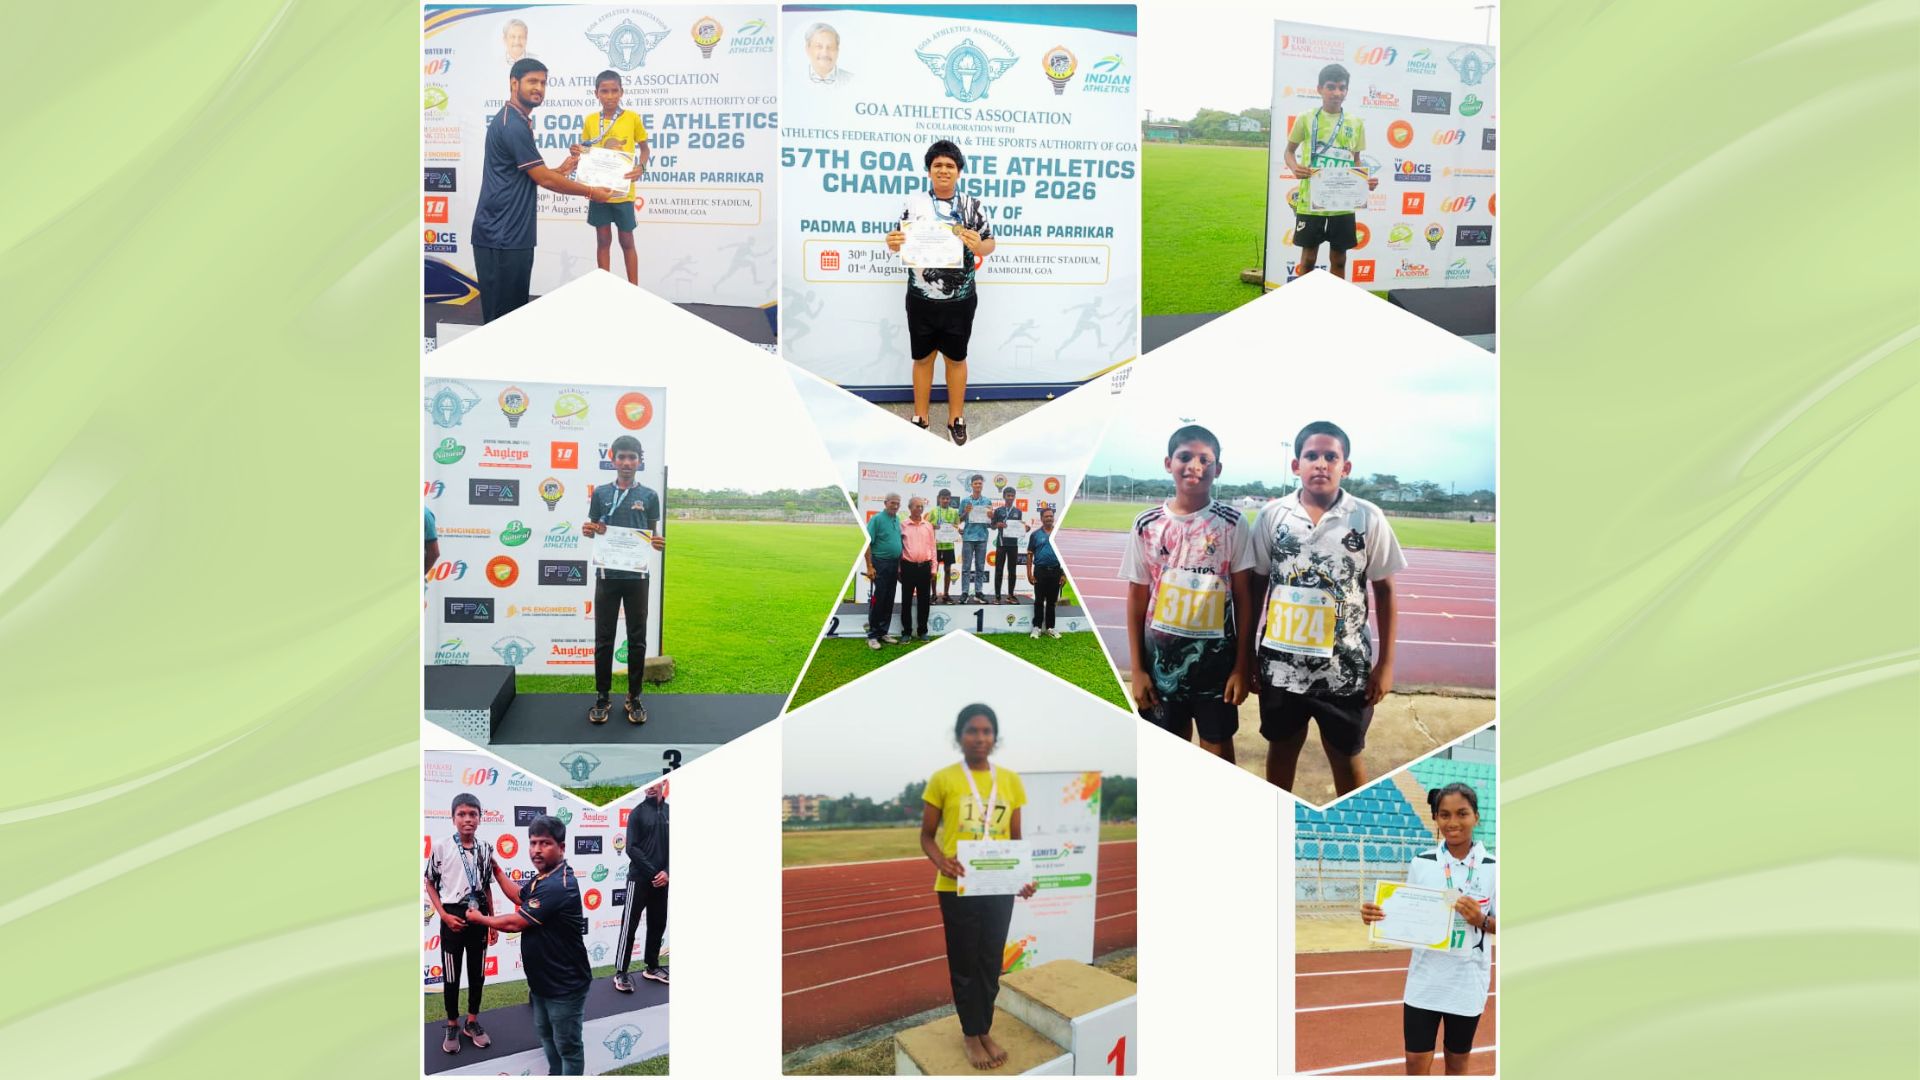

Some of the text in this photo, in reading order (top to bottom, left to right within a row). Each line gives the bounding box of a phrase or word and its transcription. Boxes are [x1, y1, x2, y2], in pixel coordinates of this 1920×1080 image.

[731, 36, 775, 46] INDIAN
[729, 45, 774, 54] ATHLETICS
[1407, 60, 1437, 70] INDIAN
[546, 76, 567, 87] OA
[635, 73, 720, 85] ASSOCIATION
[1085, 73, 1132, 85] INDIAN
[1083, 84, 1130, 94] ATHLETICS
[541, 99, 580, 108] DERATION
[584, 99, 597, 107] OF
[635, 98, 652, 107] THE
[654, 97, 688, 107] SPORTS
[690, 96, 745, 106] AUTHORITY
[747, 96, 759, 105] OF
[855, 102, 1072, 125] GOA ATHLETICS ASSOCIATION
[544, 114, 584, 130] GOA
[662, 112, 778, 130] ATHLETICS
[926, 122, 993, 132] COLLABORATION
[688, 132, 745, 149] 2026
[842, 130, 911, 143] FEDERATION
[914, 134, 928, 144] OF
[965, 136, 973, 145] &
[976, 136, 995, 146] THE
[999, 137, 1037, 148] SPORTS
[1040, 139, 1099, 150] AUTHORITY
[1101, 141, 1114, 151] OF
[1115, 142, 1137, 152] GOA
[660, 155, 677, 168] OF
[782, 147, 850, 169] 57TH
[860, 150, 914, 172] GOA
[1006, 157, 1136, 179] ATHLETICS
[1395, 160, 1432, 175] VOICE
[700, 172, 764, 183] PARRIKAR
[1035, 180, 1097, 200] 2026
[552, 193, 569, 204] July
[711, 199, 753, 208] STADIUM,
[551, 205, 581, 215] August
[1003, 206, 1022, 219] OF
[801, 219, 856, 233] PADMA
[992, 224, 1042, 237] NOHAR
[1047, 225, 1114, 239] PARRIKAR
[848, 250, 867, 260] 30th
[870, 250, 892, 262] July
[988, 255, 1101, 265] ATAL ATHLETIC STADIUM,
[848, 263, 908, 276] 01st August
[987, 267, 1033, 275] BAMBOLIM,
[483, 445, 529, 460] Angleys
[476, 484, 513, 498] FPA
[544, 535, 579, 543] INDIAN
[544, 565, 581, 578] FPA
[451, 603, 489, 615] FPA
[1162, 587, 1217, 627] 3121
[827, 617, 840, 636] 2
[973, 608, 984, 632] 1
[1271, 603, 1326, 644] 3124
[435, 651, 470, 659] INDIAN
[552, 644, 594, 658] Angleys
[663, 749, 682, 775] 3
[578, 839, 600, 850] FPA
[1032, 849, 1058, 857] ASMITA
[1107, 1035, 1126, 1075] 1
